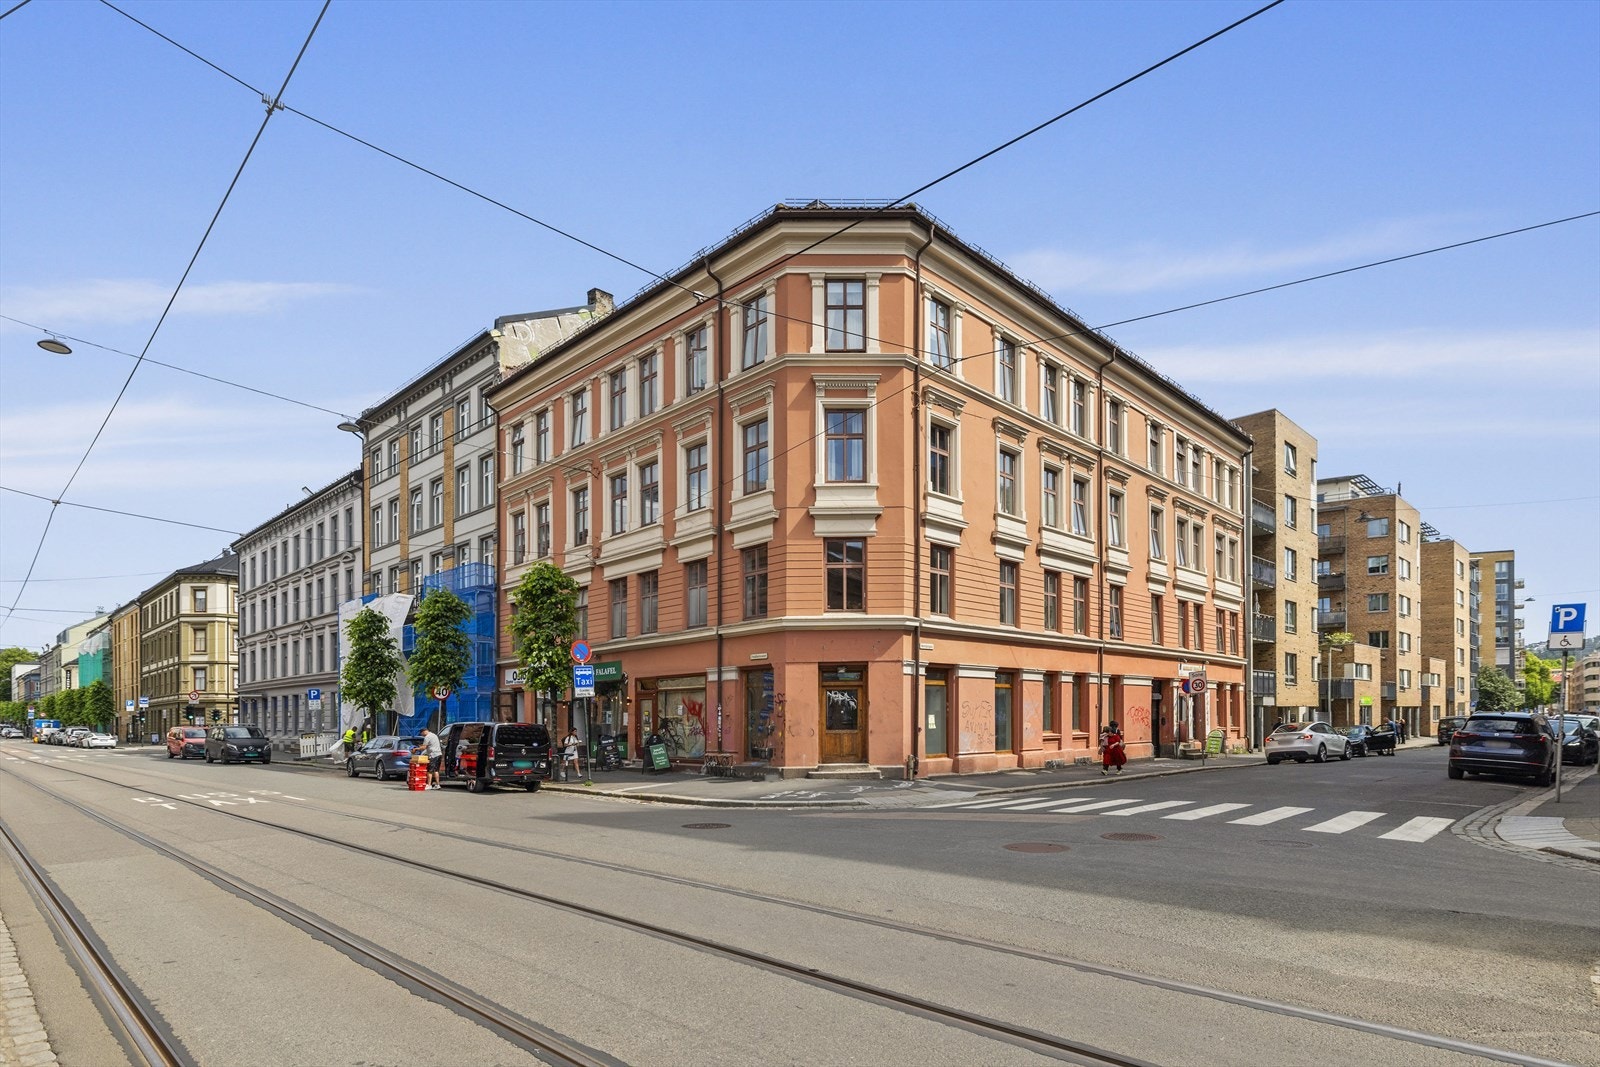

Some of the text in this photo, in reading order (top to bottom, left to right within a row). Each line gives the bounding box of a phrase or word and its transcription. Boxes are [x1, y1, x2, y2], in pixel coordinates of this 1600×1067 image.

[1559, 608, 1577, 629] P
[596, 667, 616, 675] FALAFEL
[576, 677, 592, 685] Taxi
[311, 690, 318, 698] P
[436, 688, 447, 696] 40
[150, 795, 306, 810] TAXI
